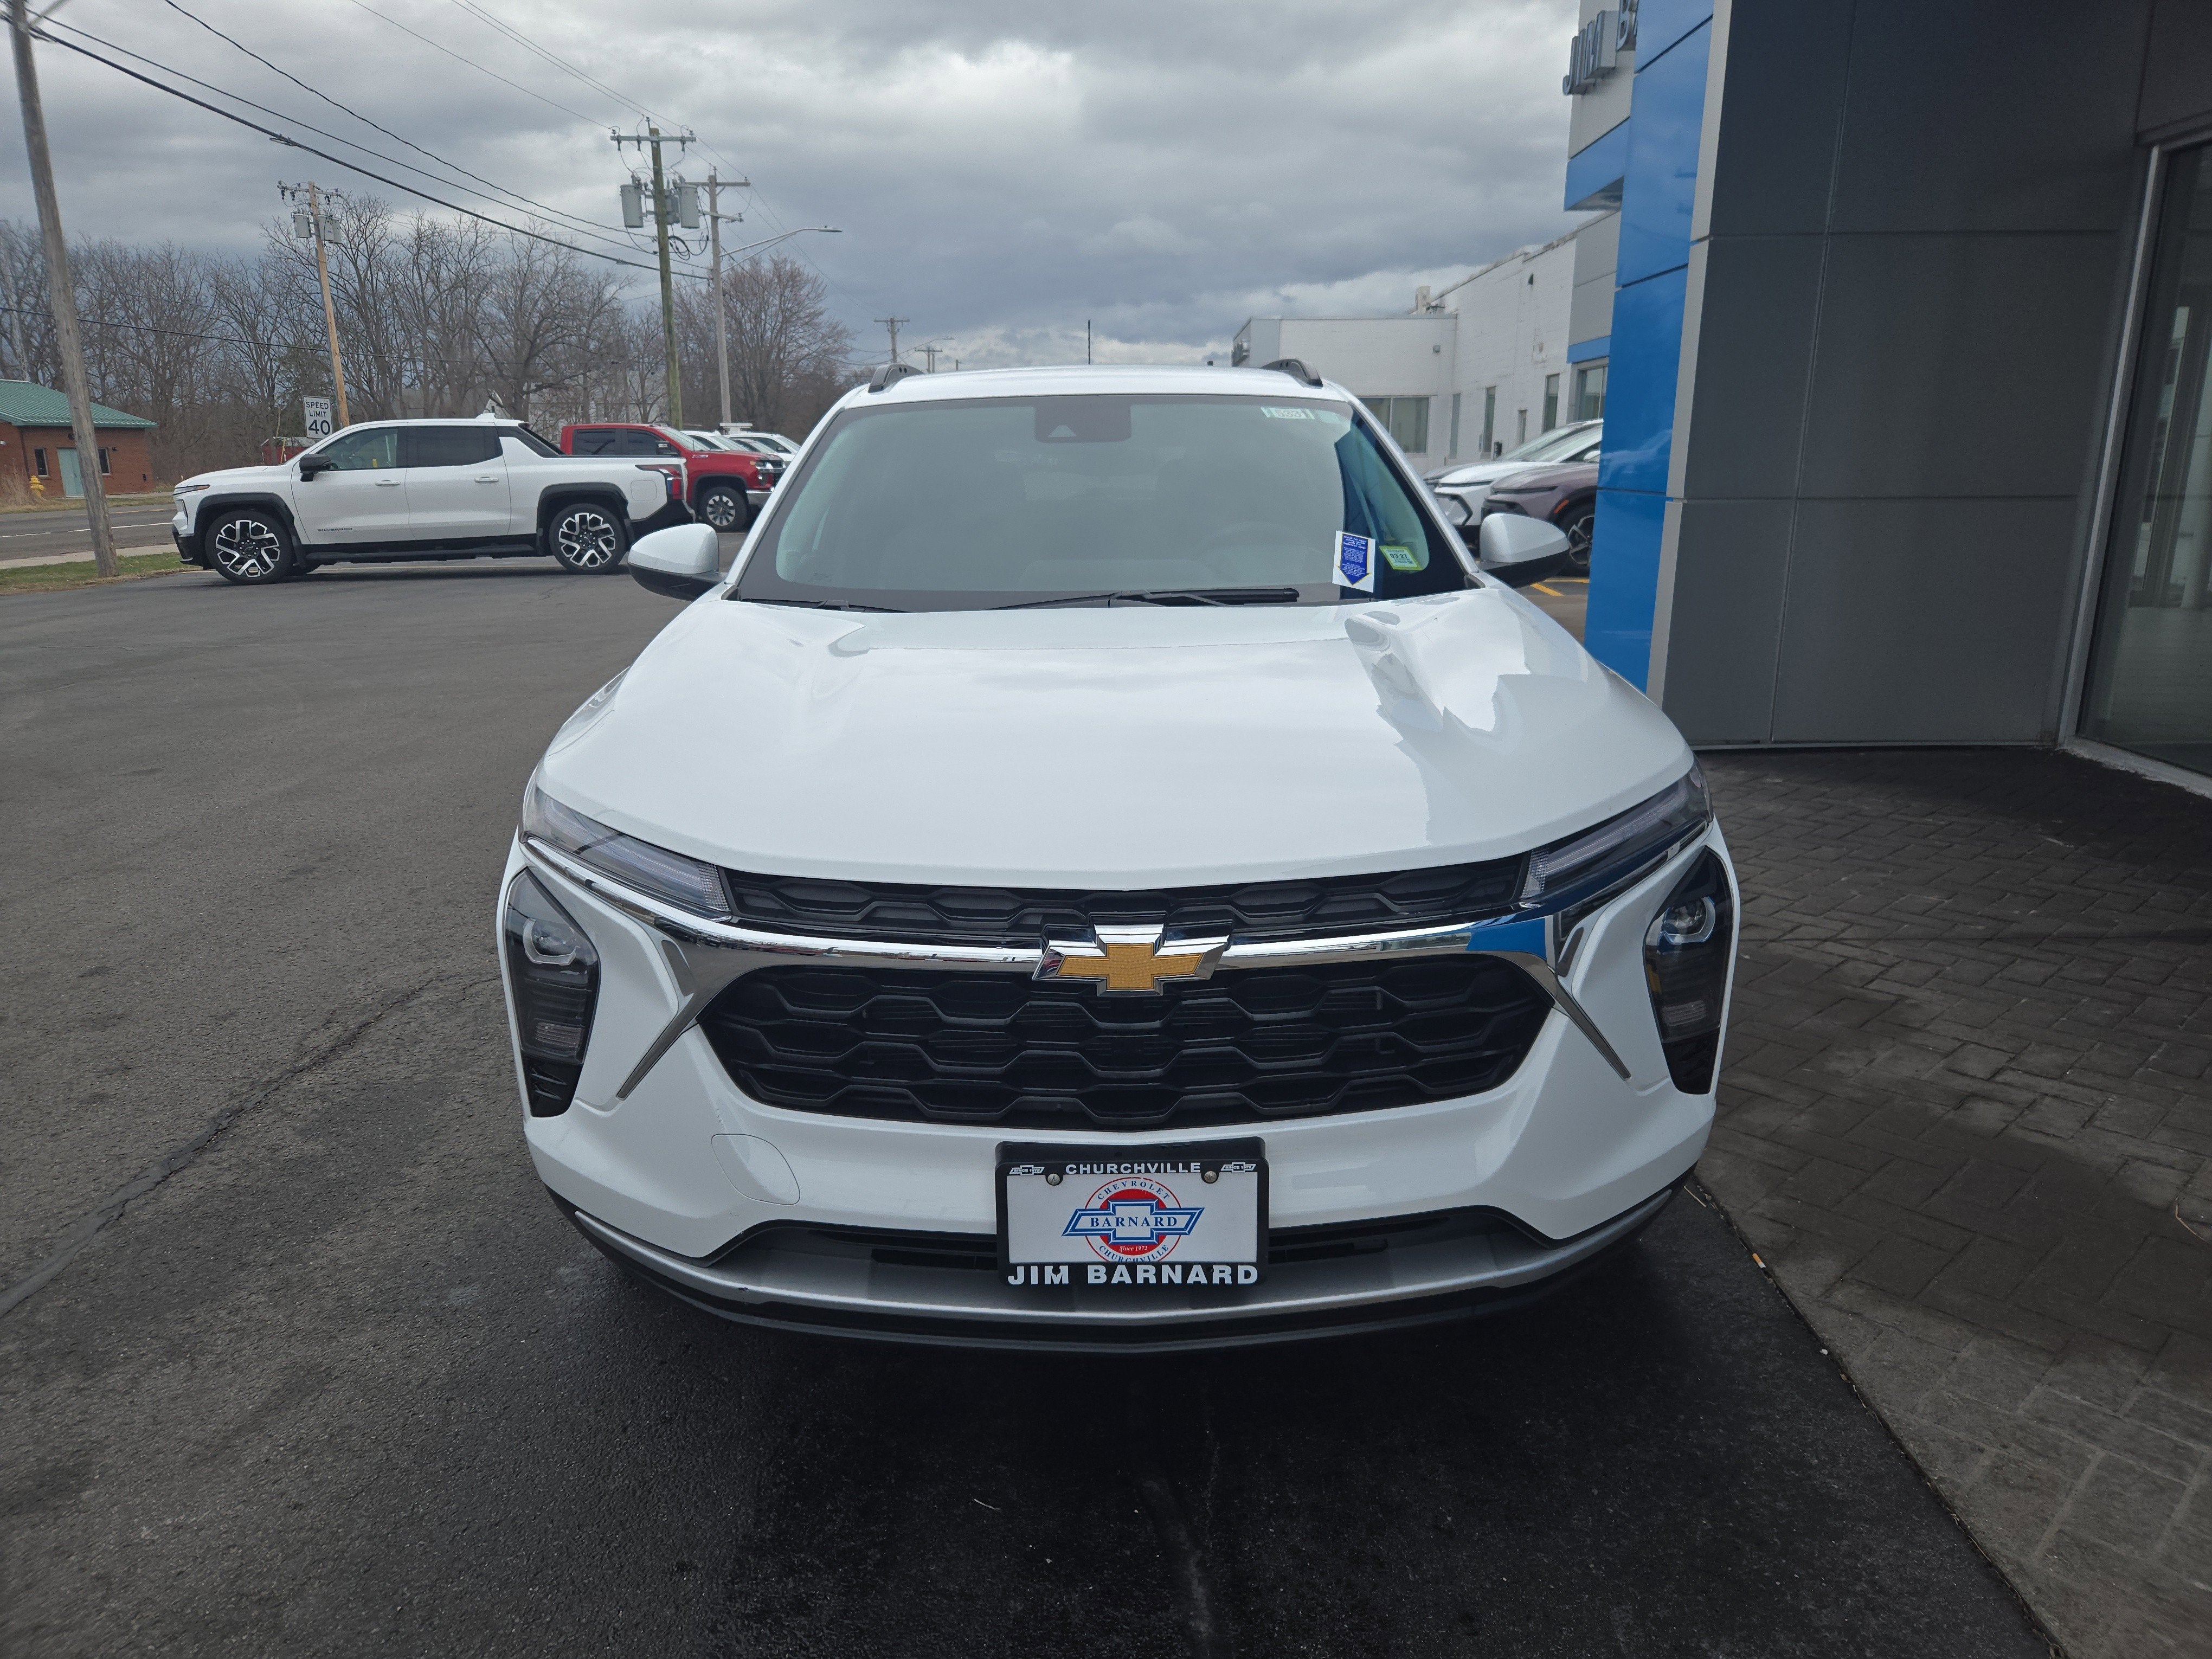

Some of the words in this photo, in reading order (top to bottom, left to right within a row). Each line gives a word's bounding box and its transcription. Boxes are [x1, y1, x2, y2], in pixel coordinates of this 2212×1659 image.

[306, 401, 329, 409] SPEED
[308, 419, 331, 435] 40
[1065, 1162, 1201, 1174] CHURCHVILLE
[1097, 1180, 1170, 1200] CHEVROLET
[1090, 1216, 1178, 1227] BARNARD
[1007, 1265, 1069, 1285] JIM
[1087, 1264, 1258, 1285] BARNARD
